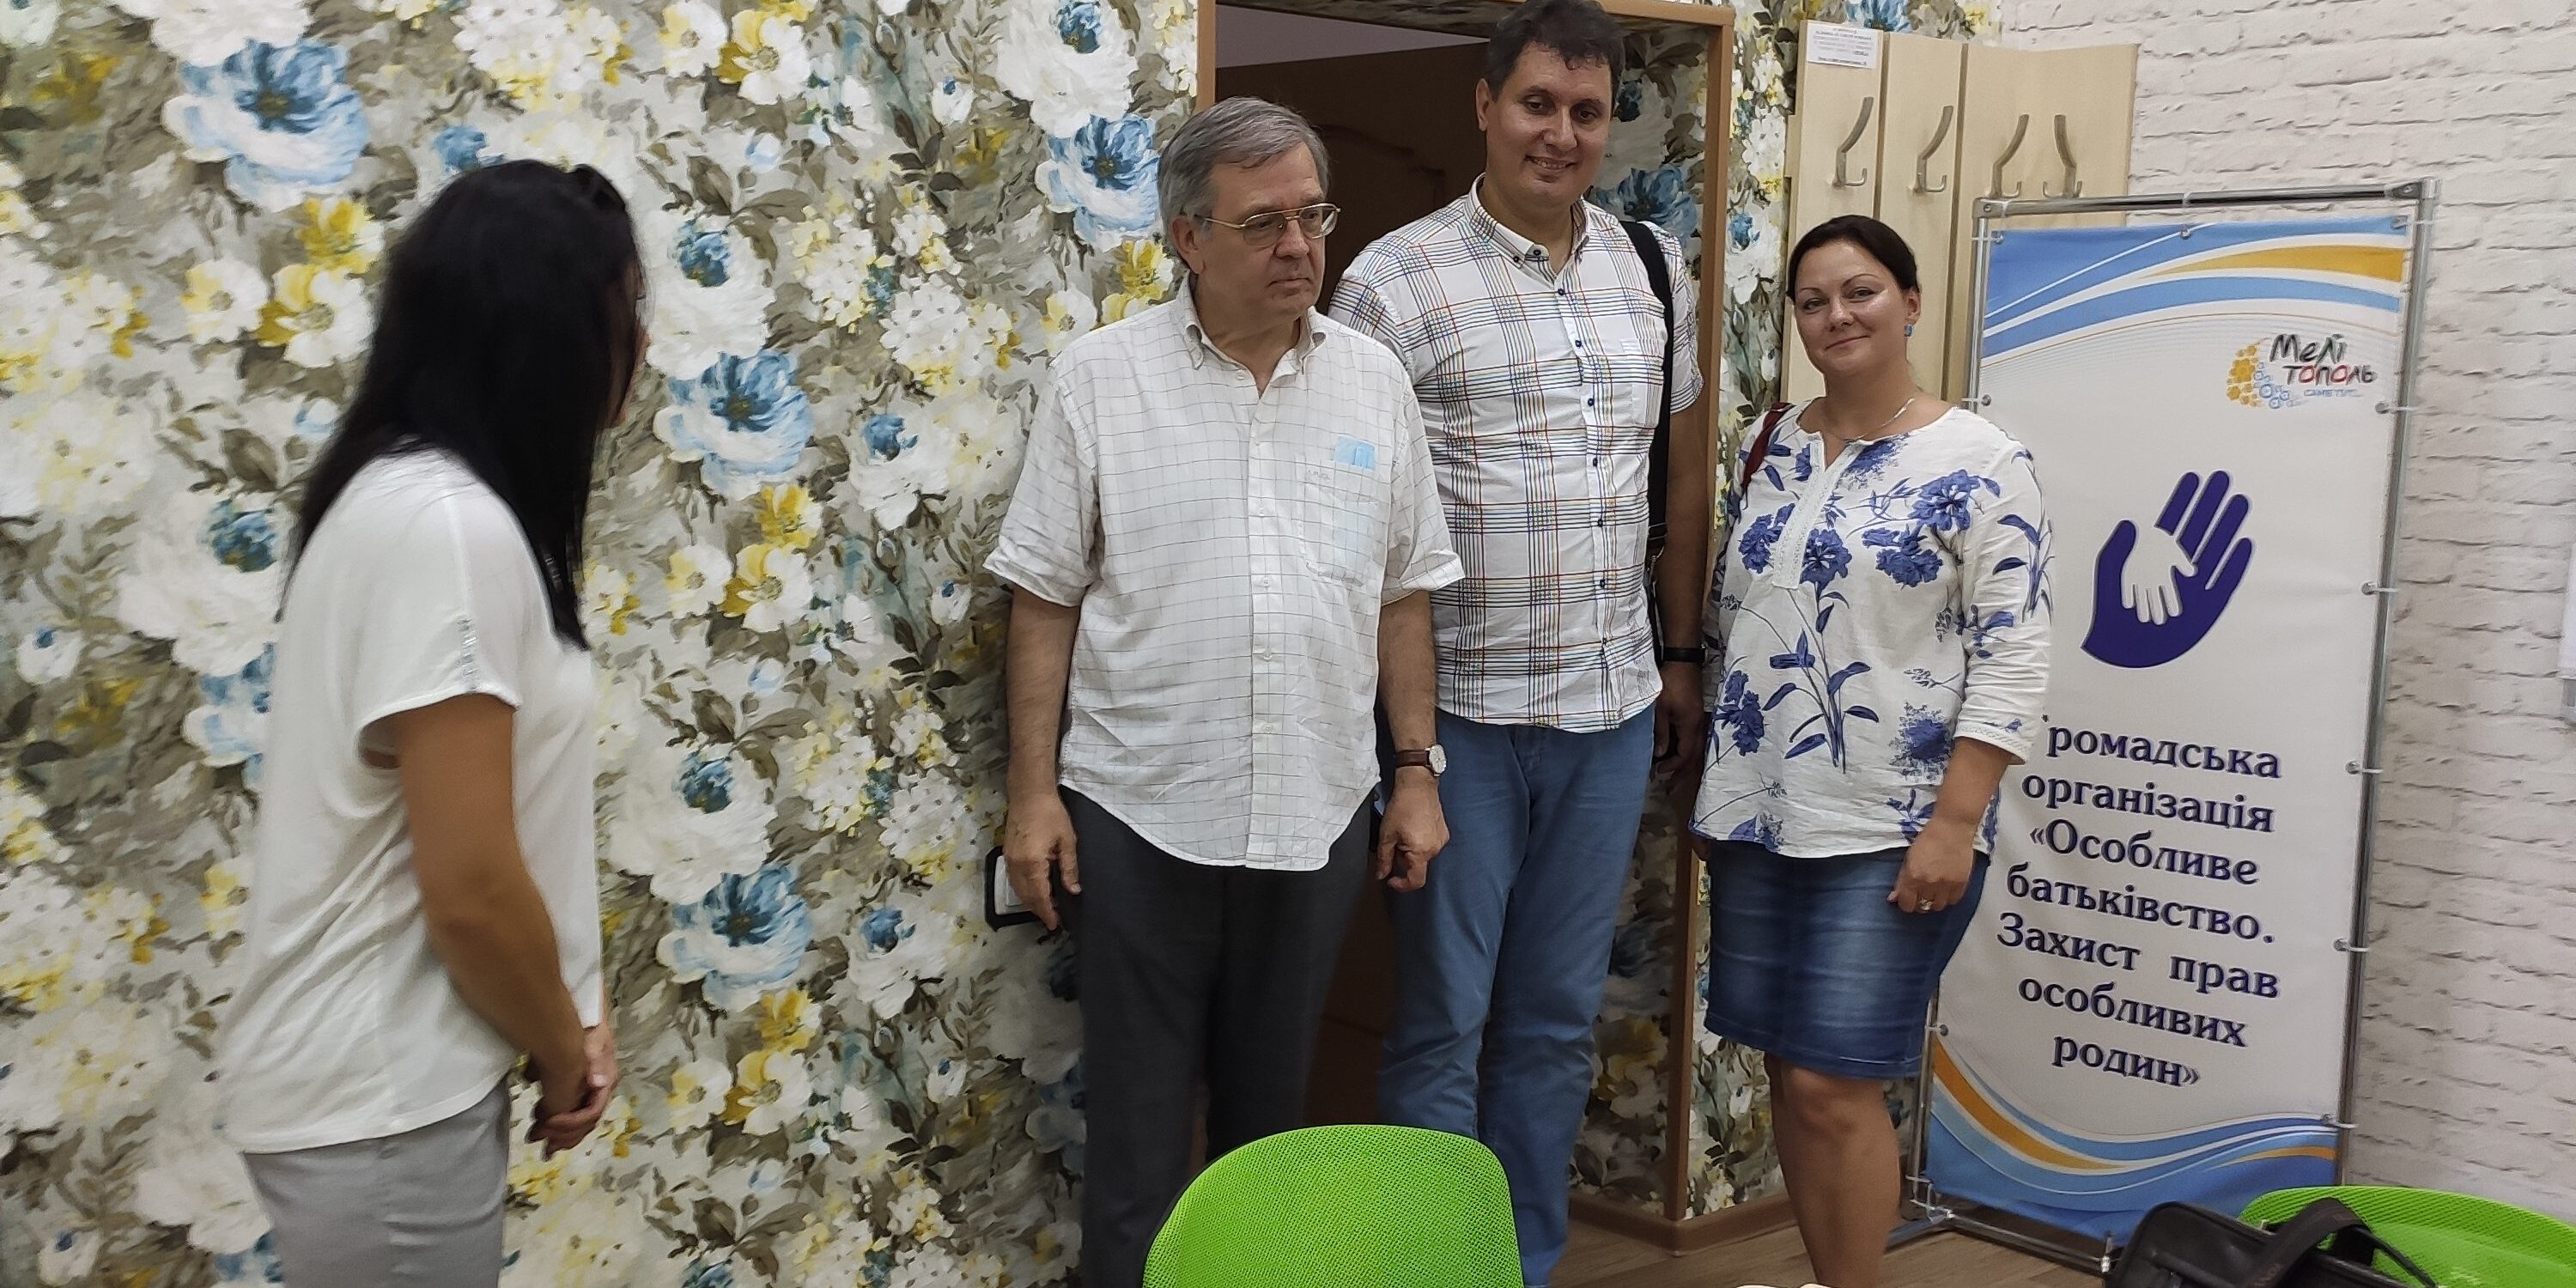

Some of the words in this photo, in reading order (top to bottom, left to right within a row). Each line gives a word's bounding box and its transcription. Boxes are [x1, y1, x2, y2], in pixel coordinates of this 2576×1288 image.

[2043, 715, 2281, 778] ромадська
[2022, 775, 2275, 833] організація
[2029, 818, 2259, 884] «Особливе
[2007, 862, 2274, 943] батьківство.
[1996, 912, 2141, 970] Захист
[2169, 955, 2279, 998] прав
[2019, 978, 2247, 1047] особливих
[2051, 1035, 2199, 1086] родин»
